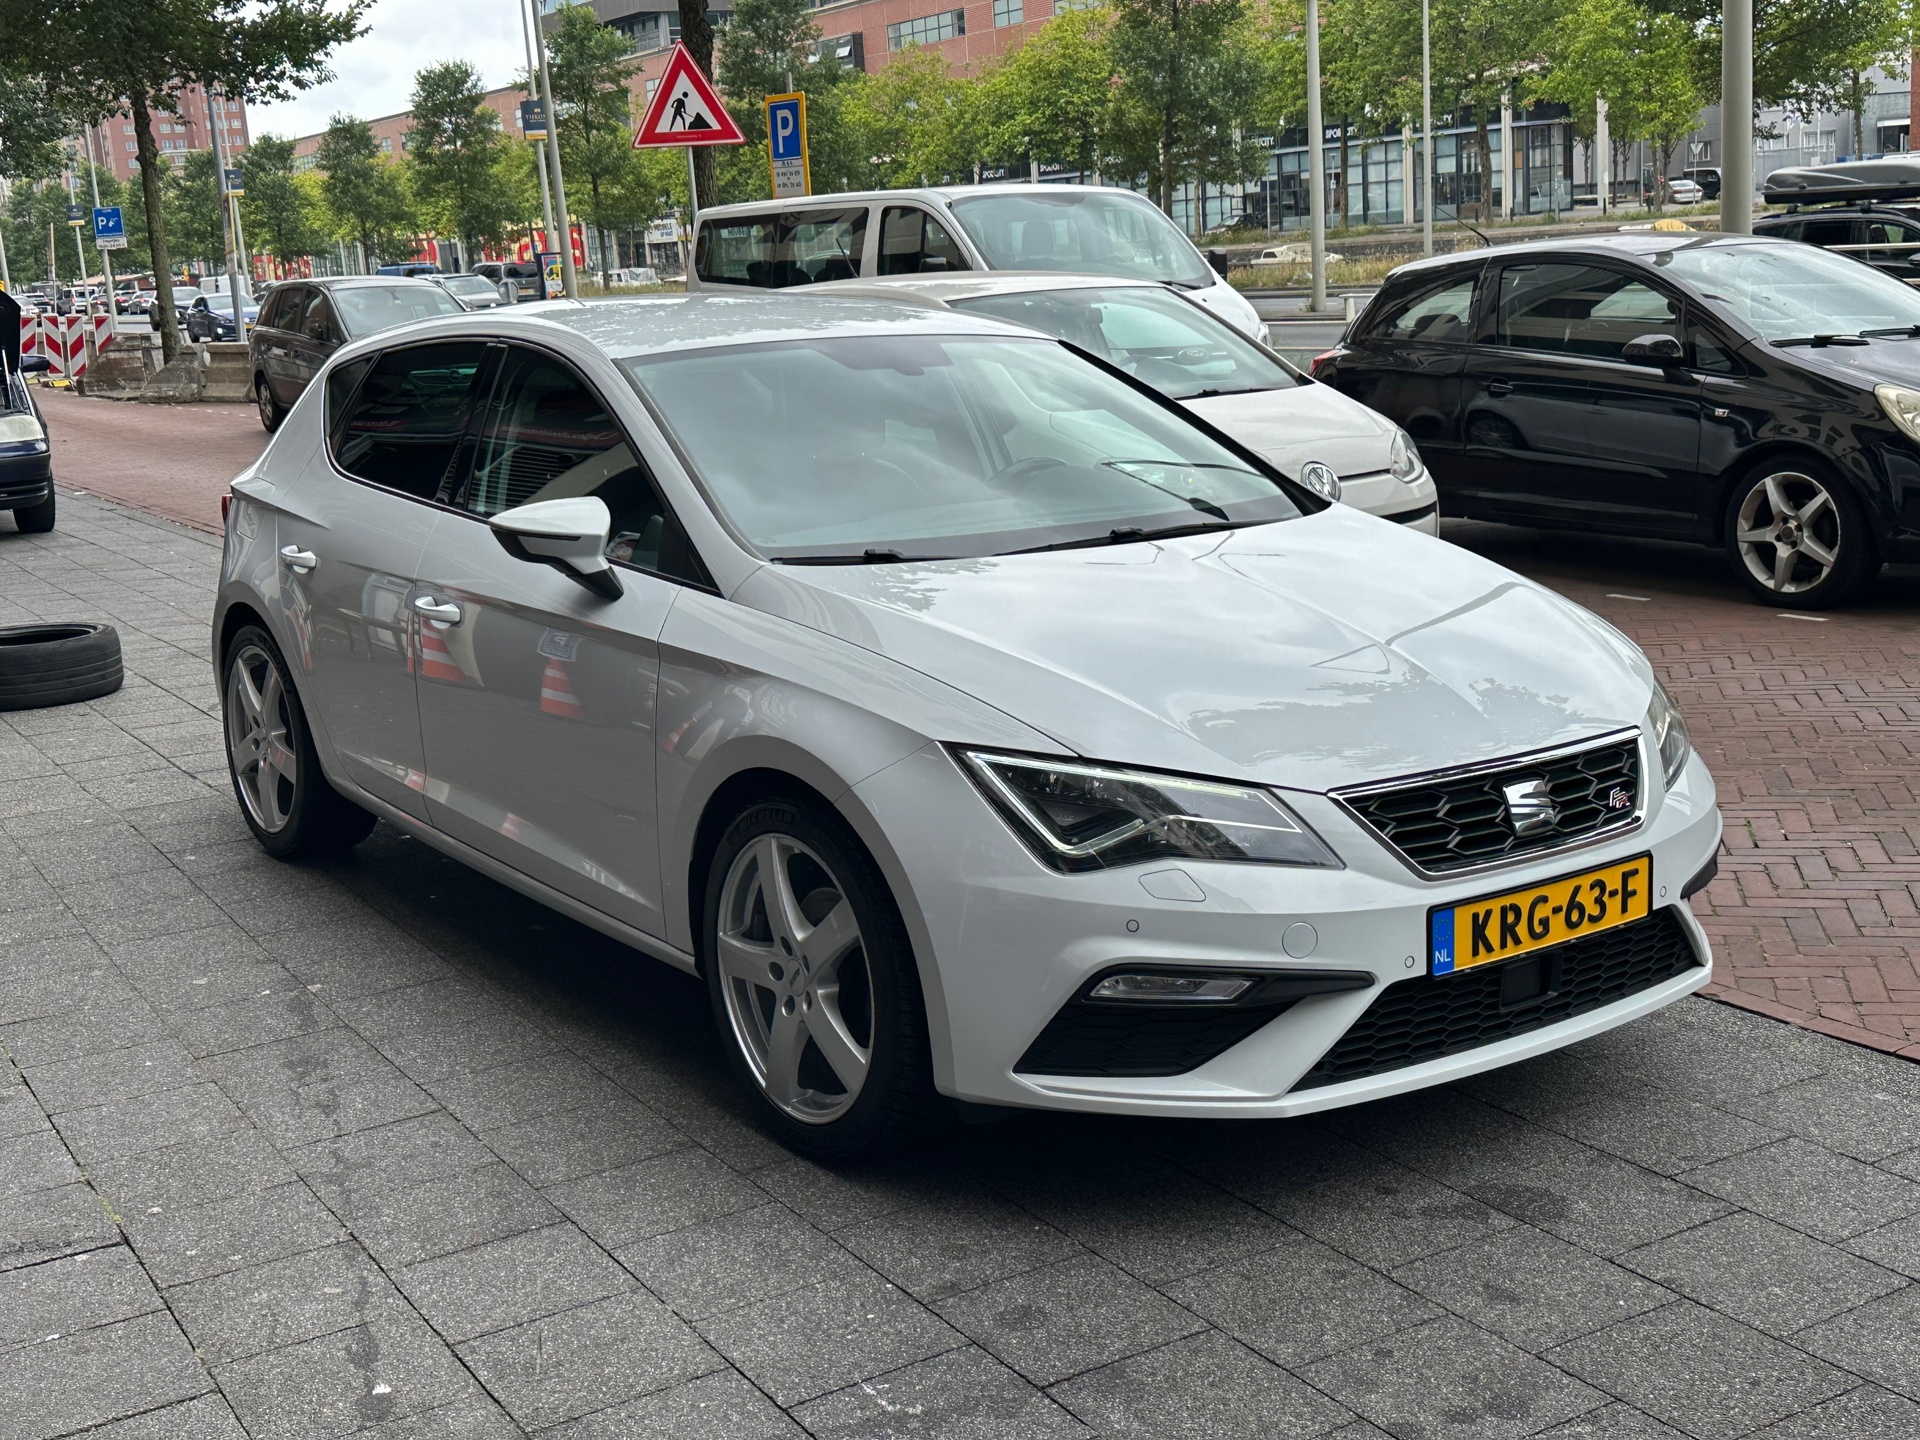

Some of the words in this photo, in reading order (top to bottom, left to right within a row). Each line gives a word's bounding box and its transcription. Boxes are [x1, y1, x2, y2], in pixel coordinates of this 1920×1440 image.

[776, 109, 793, 154] P
[97, 216, 107, 230] P
[1609, 786, 1631, 809] FR
[1471, 868, 1639, 958] KRG-63-F
[1434, 949, 1451, 964] NL
